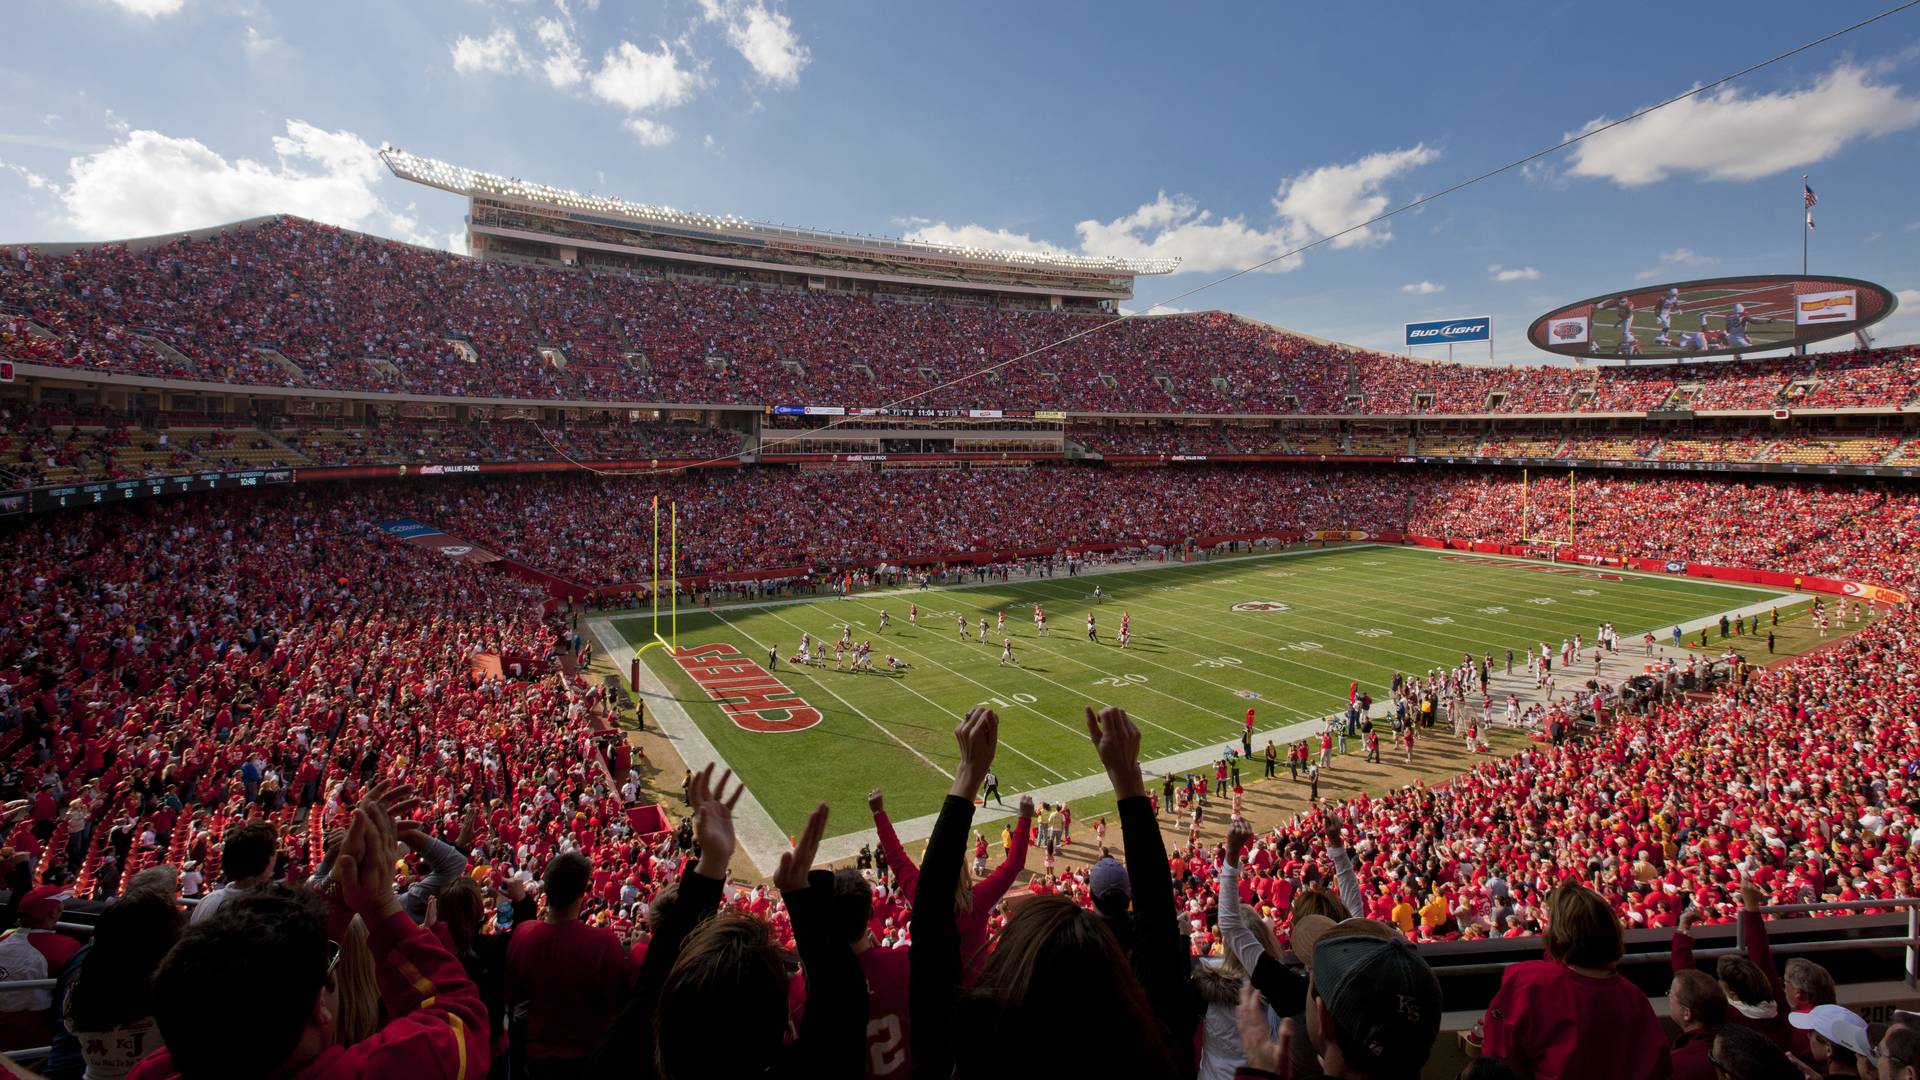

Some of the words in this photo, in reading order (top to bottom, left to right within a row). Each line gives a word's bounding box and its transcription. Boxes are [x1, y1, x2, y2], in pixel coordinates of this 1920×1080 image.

[1410, 329, 1440, 338] BUD
[1445, 325, 1485, 335] LIGHT
[1666, 462, 1690, 470] 11:04
[1287, 641, 1323, 652] 40
[1199, 656, 1242, 668] 30
[661, 642, 823, 733] CHIEFS
[1100, 673, 1149, 688] 20
[989, 693, 1037, 708] 10
[866, 1014, 905, 1076] 2
